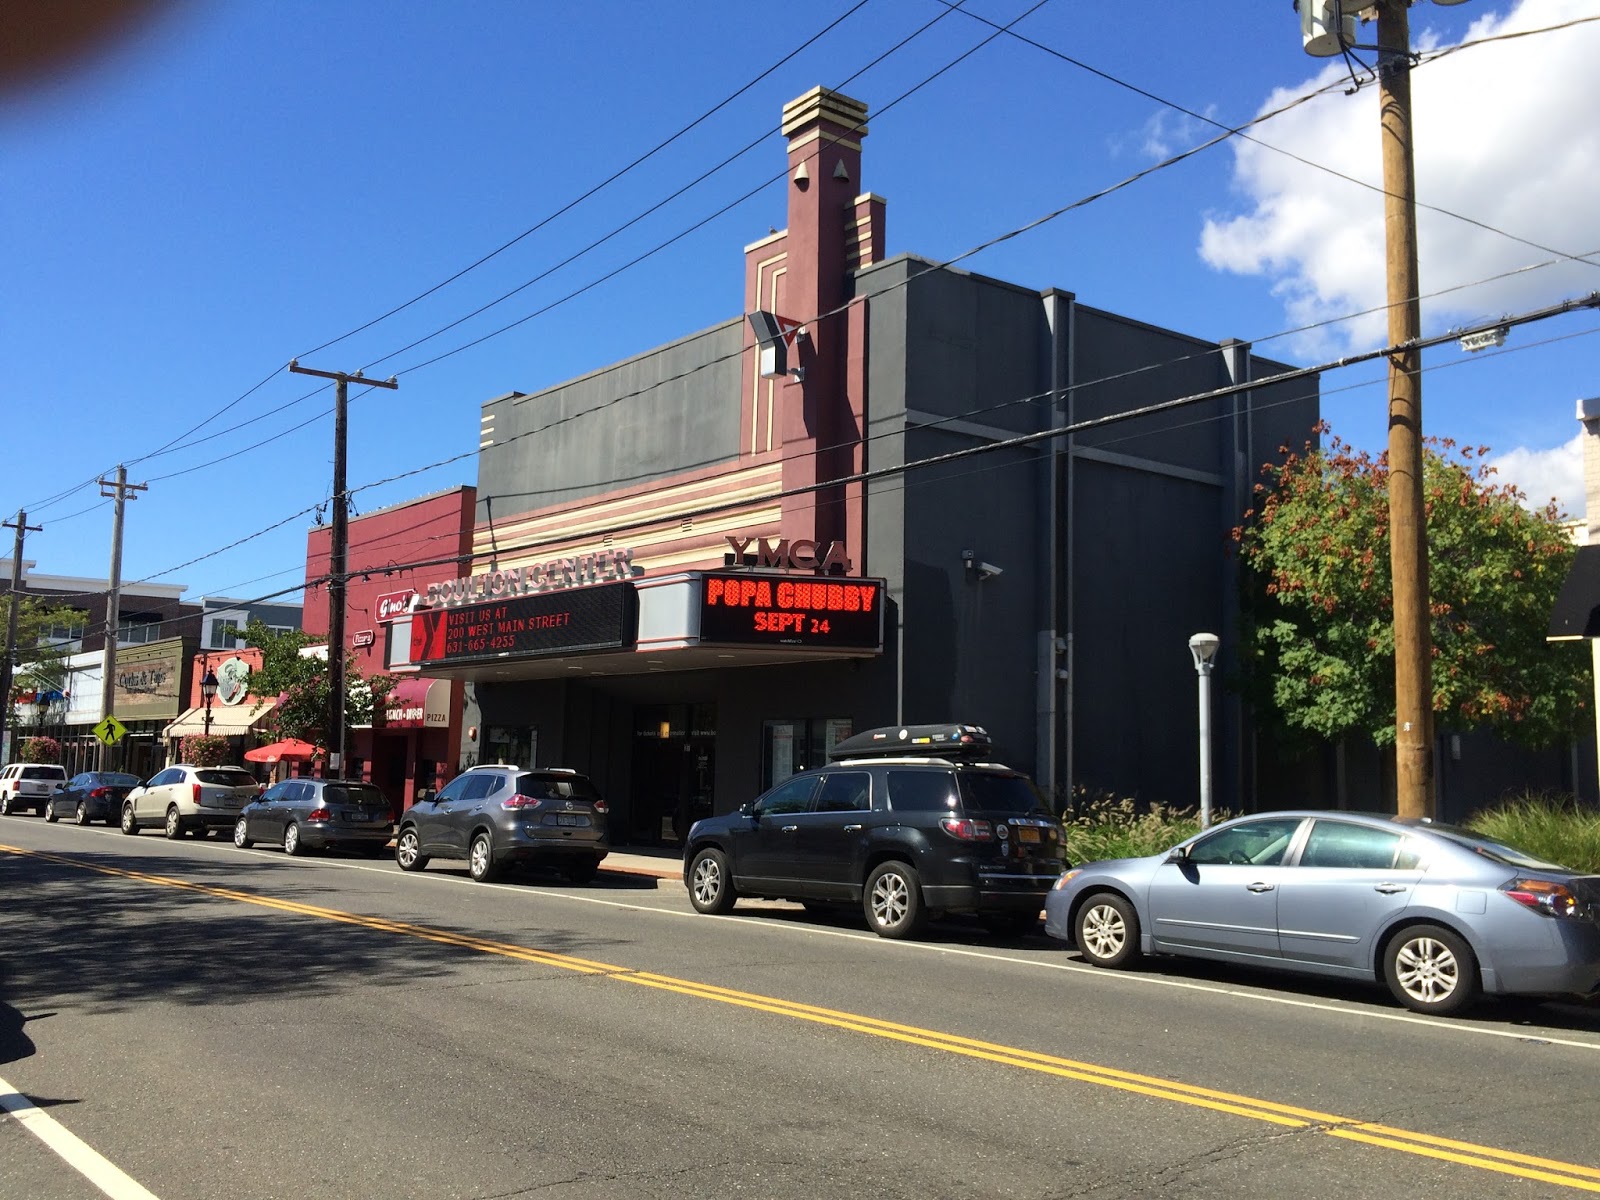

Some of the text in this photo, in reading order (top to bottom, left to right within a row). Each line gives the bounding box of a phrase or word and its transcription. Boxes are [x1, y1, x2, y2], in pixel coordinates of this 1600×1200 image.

[724, 536, 853, 571] YMCA
[425, 548, 633, 604] BOULTON CENTER
[708, 579, 876, 612] POPA CHUBBY
[448, 612, 570, 640] 200 WEST MAIN STREET
[449, 606, 508, 625] VISIT US AT
[754, 611, 831, 634] SEPT 24
[447, 634, 515, 653] 631-665-4255
[426, 713, 446, 722] PIZZA
